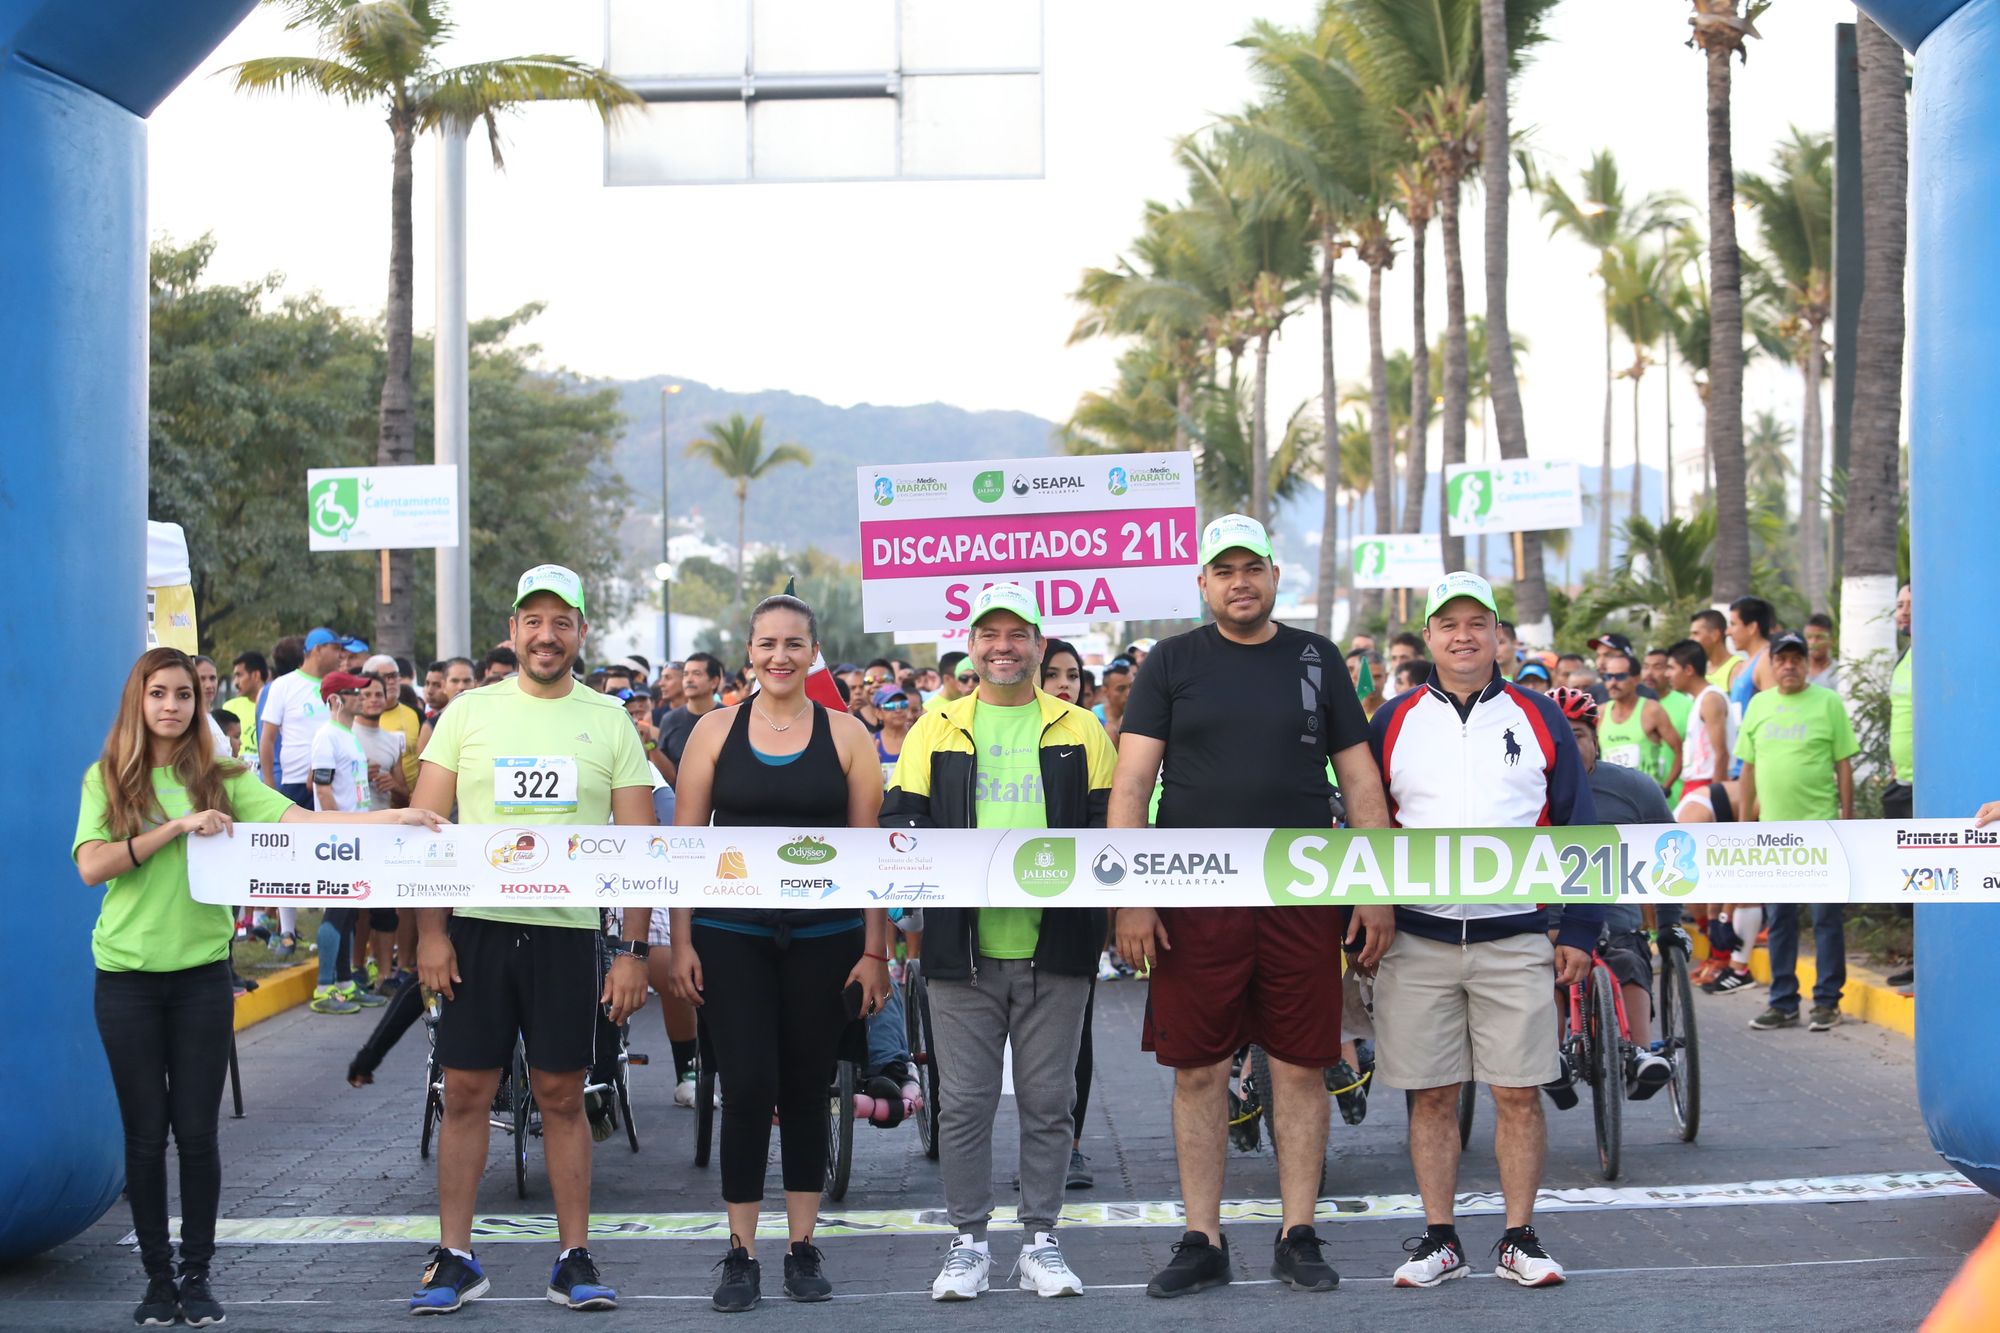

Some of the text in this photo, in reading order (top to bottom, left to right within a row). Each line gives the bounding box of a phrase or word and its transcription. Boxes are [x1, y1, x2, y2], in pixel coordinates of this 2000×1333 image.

[1032, 476, 1085, 489] SEAPAL
[365, 496, 450, 508] Calentamiento
[872, 518, 1189, 566] DISCAPACITADOS 21k
[944, 577, 1120, 622] SIDA
[1299, 655, 1321, 663] Reebok
[513, 770, 559, 798] 322
[975, 772, 1043, 803] Staff
[251, 833, 290, 848] FOOD
[670, 837, 705, 849] CAEA
[1896, 828, 1998, 845] Primera Plus
[314, 834, 361, 861] ciel
[580, 838, 626, 854] OCV
[787, 846, 827, 859] Odyssey
[1706, 845, 1828, 866] MARATÓN
[1132, 853, 1238, 875] SEAPAL
[1285, 834, 1565, 898] SALIDA
[1558, 842, 1648, 896] 21k
[1022, 869, 1068, 880] JALISCO
[1737, 869, 1774, 878] Carrera
[1776, 868, 1828, 878] Recreativa
[1901, 868, 1957, 891] X3M
[249, 879, 350, 895] Primera Plus
[500, 884, 571, 893] HONDA
[622, 877, 679, 894] twofly
[703, 886, 763, 896] CARACOL
[780, 879, 833, 889] POWER
[866, 882, 912, 901] Vallarta
[780, 888, 810, 898] ADE
